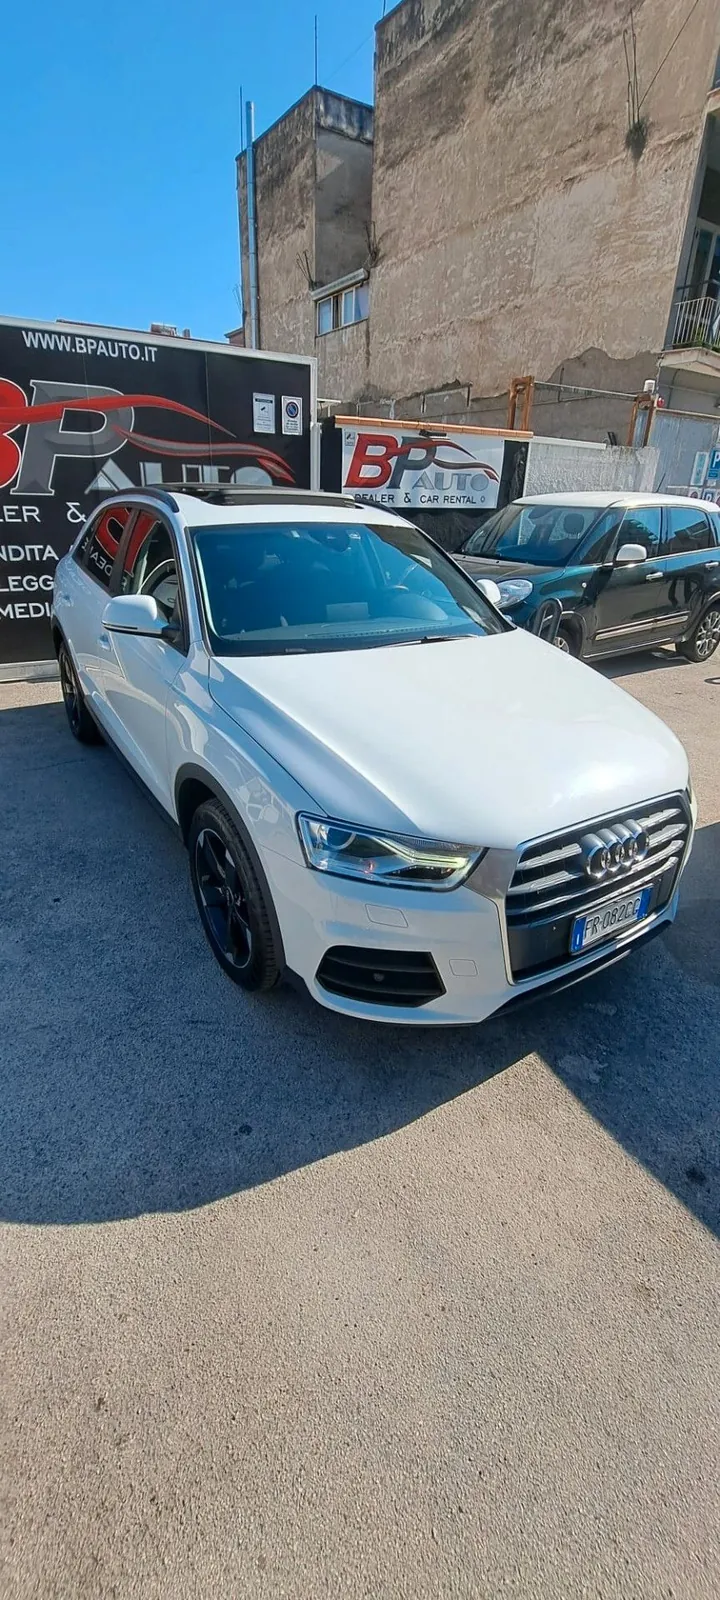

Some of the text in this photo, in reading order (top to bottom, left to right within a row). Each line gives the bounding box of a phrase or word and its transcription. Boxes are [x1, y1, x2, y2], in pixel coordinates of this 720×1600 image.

[21, 331, 157, 362] WWW.BPAUTO.IT
[343, 433, 437, 489] BP
[412, 472, 489, 491] AUTO
[403, 492, 412, 504] &
[420, 494, 439, 504] CAR
[443, 495, 476, 504] RENTAL
[0, 502, 87, 523] ER &
